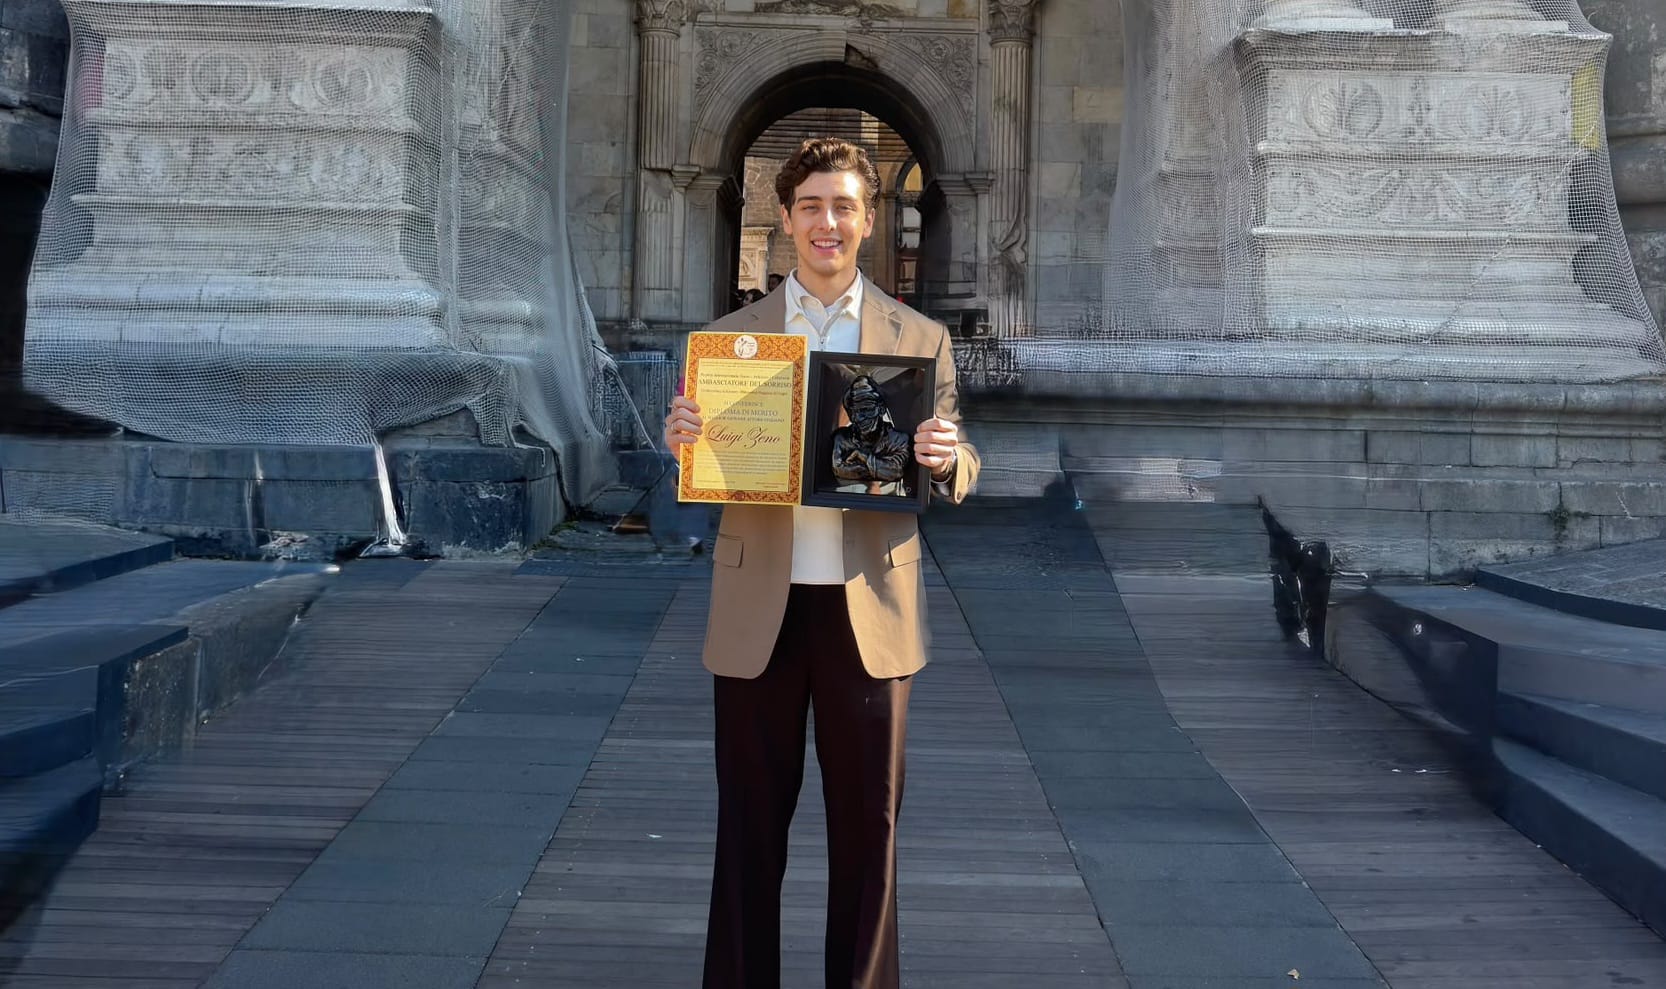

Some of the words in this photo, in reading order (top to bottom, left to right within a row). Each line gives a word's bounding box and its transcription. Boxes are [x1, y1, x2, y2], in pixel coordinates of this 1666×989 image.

[751, 409, 778, 417] MERITO
[707, 425, 743, 448] Luigi
[744, 427, 780, 449] Zeno
